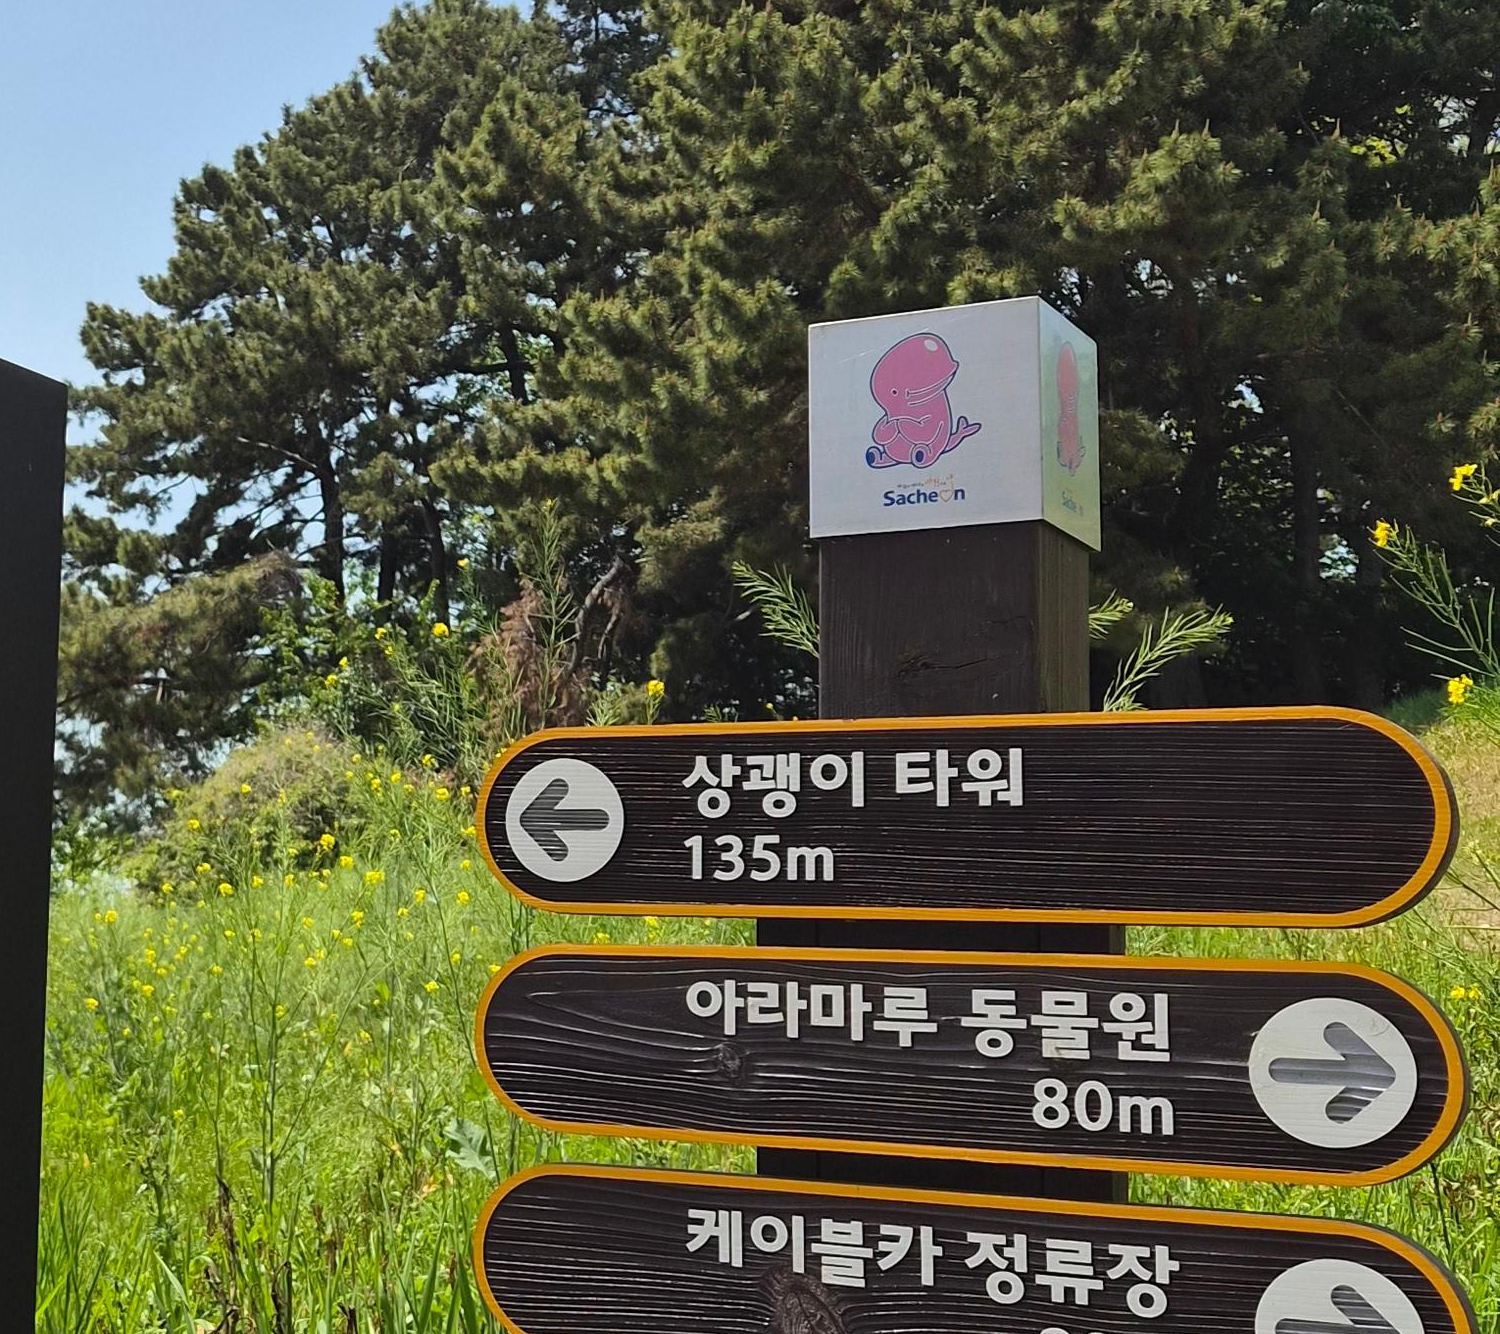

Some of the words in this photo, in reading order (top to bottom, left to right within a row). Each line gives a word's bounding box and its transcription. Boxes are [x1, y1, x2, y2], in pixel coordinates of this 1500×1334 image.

[682, 752, 866, 819] 상괭이
[894, 747, 1024, 807] 타워
[684, 834, 834, 882] 135m
[686, 979, 938, 1047] 아라마루
[961, 989, 1171, 1061] 동물원
[1032, 1078, 1175, 1135] 80m
[686, 1208, 943, 1288] 케이블카
[964, 1231, 1181, 1318] 정류장
